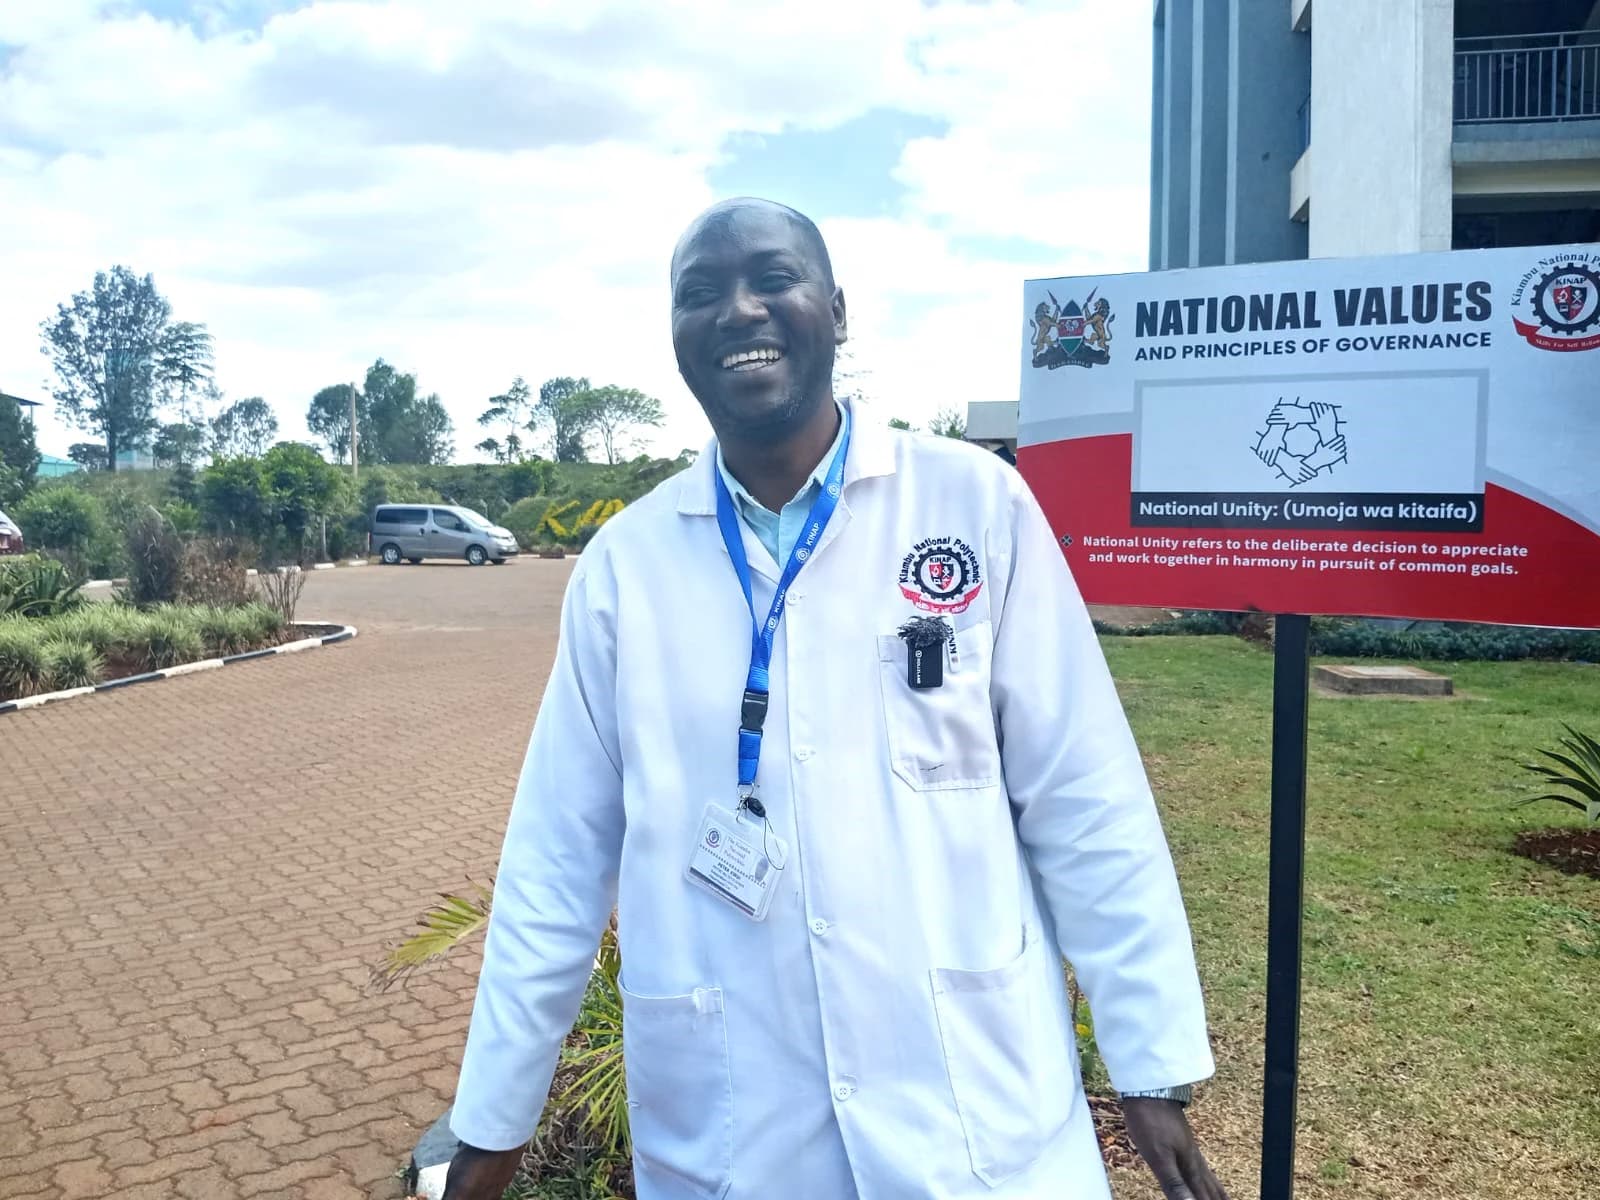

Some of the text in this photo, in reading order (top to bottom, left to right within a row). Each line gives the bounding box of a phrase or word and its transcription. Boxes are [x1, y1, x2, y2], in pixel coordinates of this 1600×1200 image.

[1511, 253, 1589, 306] Kiambu National
[1555, 277, 1585, 285] KINAP
[1135, 281, 1492, 337] NATIONAL VALUES
[1135, 332, 1492, 361] AND PRINCIPLES OF GOVERNANCE
[1139, 499, 1477, 523] National Unity: (Umoja wa kitaifa)
[806, 522, 820, 546] KINAP
[1083, 536, 1528, 558] National Unity refers to the deliberate decision to appreciate
[899, 536, 980, 584] Kiambu National Polytechnic
[1089, 552, 1519, 576] and work together in harmony in pursuit of common goals.
